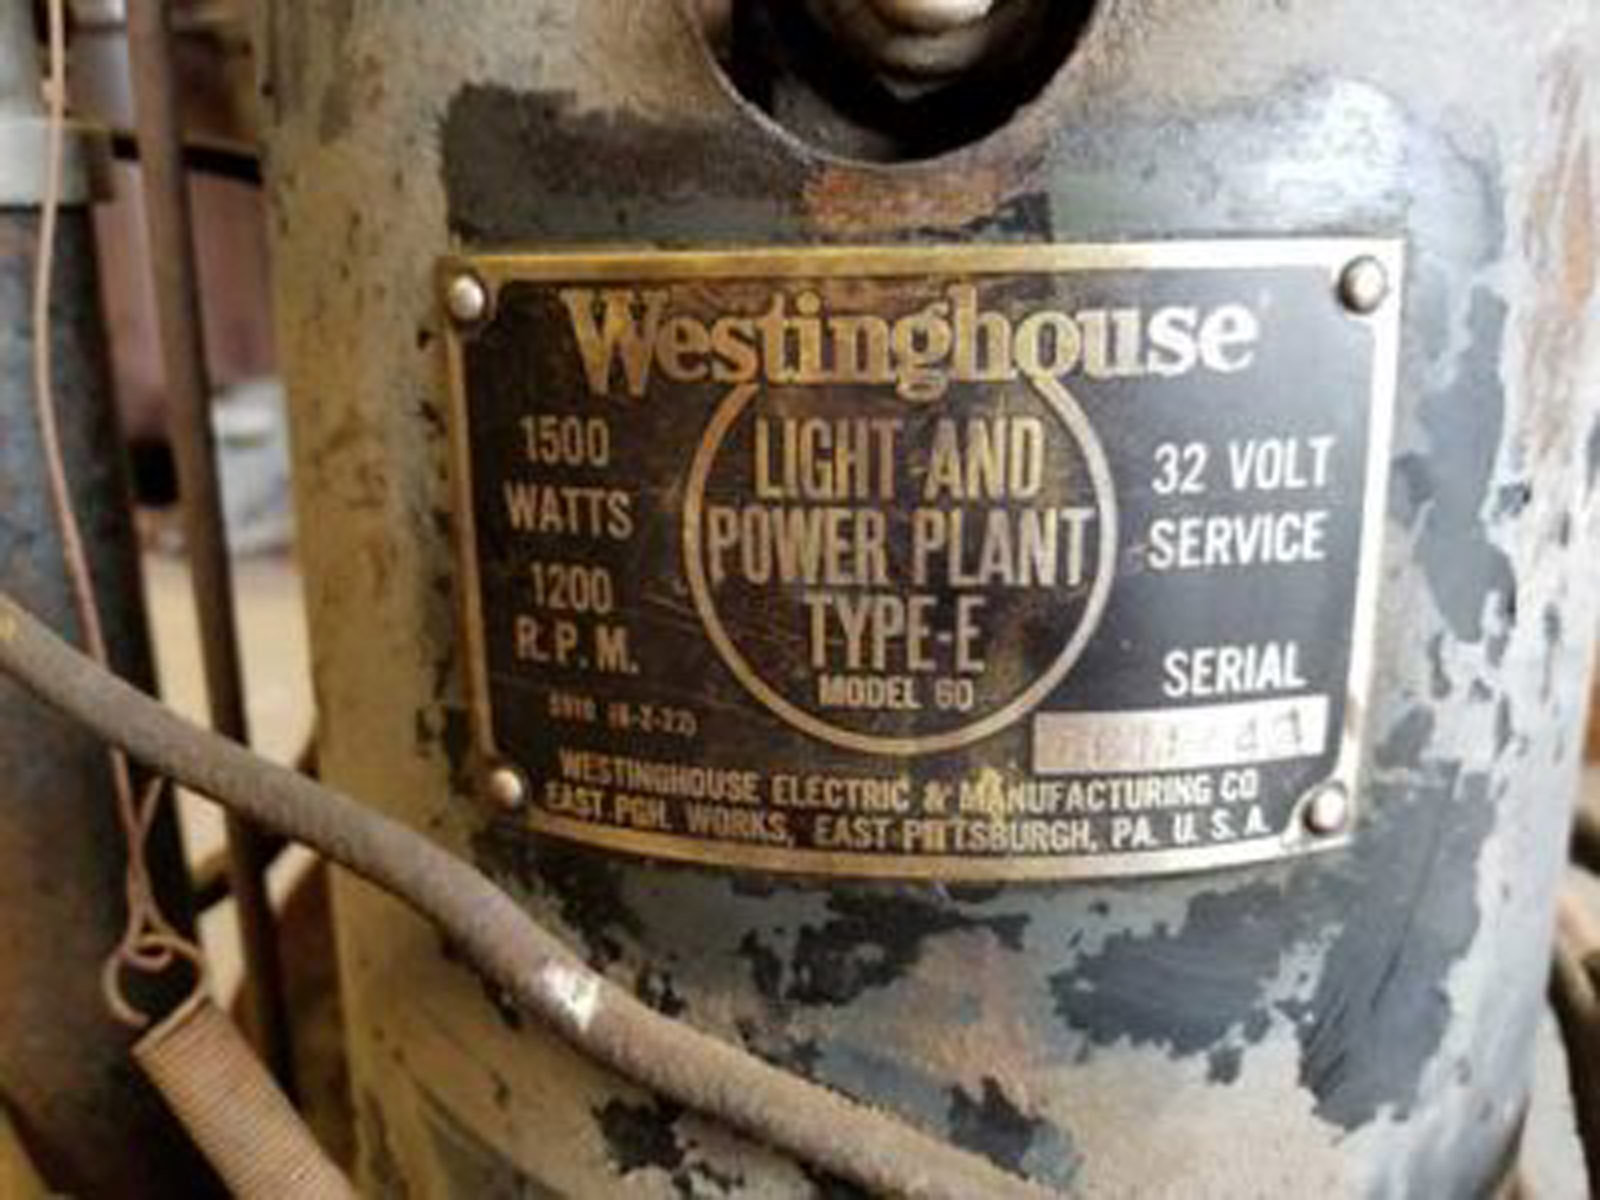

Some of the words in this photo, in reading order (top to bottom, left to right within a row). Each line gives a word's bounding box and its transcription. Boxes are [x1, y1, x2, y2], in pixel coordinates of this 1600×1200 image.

[560, 283, 1260, 399] Westinghouse
[519, 414, 609, 466] 1500
[753, 417, 900, 500] LIGHT
[924, 418, 1046, 500] AND
[1151, 443, 1206, 495] 32
[1229, 437, 1336, 491] VOLT
[504, 484, 634, 540] WATTS
[1147, 511, 1329, 570] SERVICE
[707, 506, 889, 588] POWER
[910, 508, 1096, 588] PLANT
[530, 561, 614, 615] 1200
[803, 596, 986, 672] TYPE-E
[818, 675, 921, 711] MODEL
[1162, 642, 1307, 697] SERIAL
[558, 749, 761, 805] WESTINGHOUSE
[771, 774, 911, 813] ELECTRIC
[957, 772, 1214, 816] MANUFACTURING
[813, 816, 888, 846] EAST
